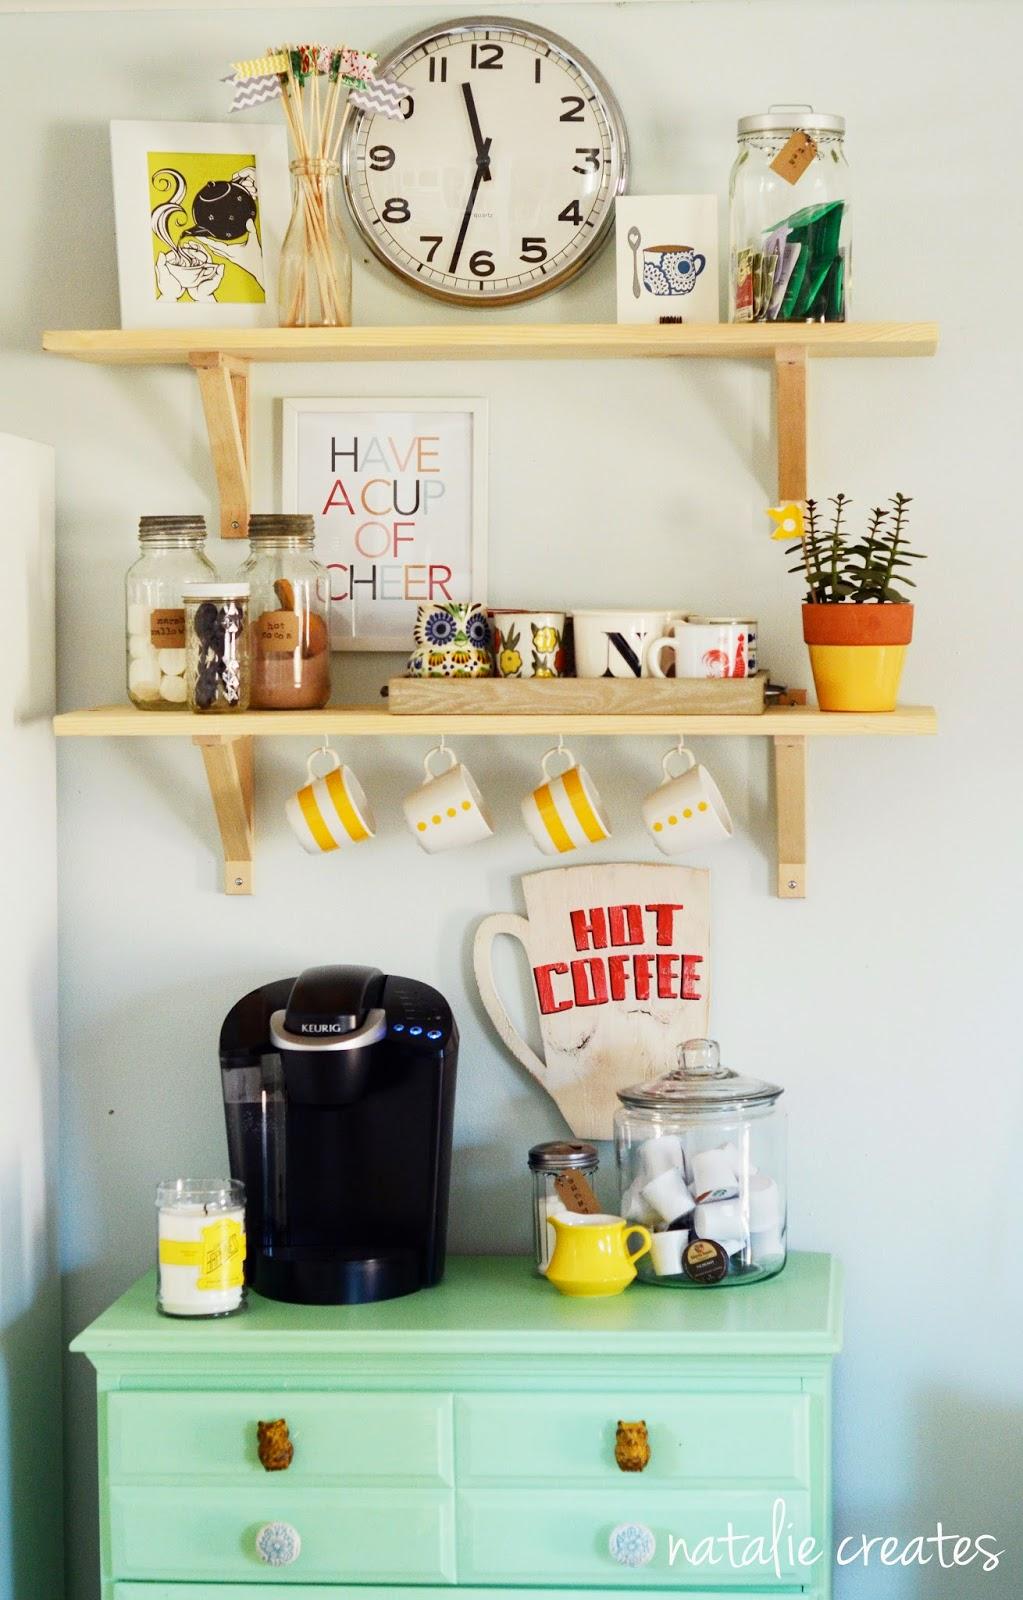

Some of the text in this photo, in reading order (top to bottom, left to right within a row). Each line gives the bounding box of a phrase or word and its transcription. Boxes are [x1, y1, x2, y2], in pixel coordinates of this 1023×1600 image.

[429, 57, 447, 82] 11
[471, 44, 504, 69] 12
[535, 58, 541, 83] 1
[398, 95, 414, 119] 0
[559, 96, 585, 122] 2
[369, 145, 396, 172] 9
[572, 148, 600, 175] 3
[382, 198, 411, 224] 8
[558, 200, 584, 226] 4
[420, 236, 443, 262] 7
[519, 237, 547, 263] 5
[469, 250, 496, 277] 6
[331, 436, 440, 472] HAVE
[322, 478, 445, 516] A CUP
[354, 521, 415, 559] OF
[316, 563, 452, 601] CHEER
[600, 632, 648, 679] N
[570, 904, 683, 952] HOT
[533, 953, 704, 1015] COFFEE
[301, 1023, 342, 1033] KEURIG
